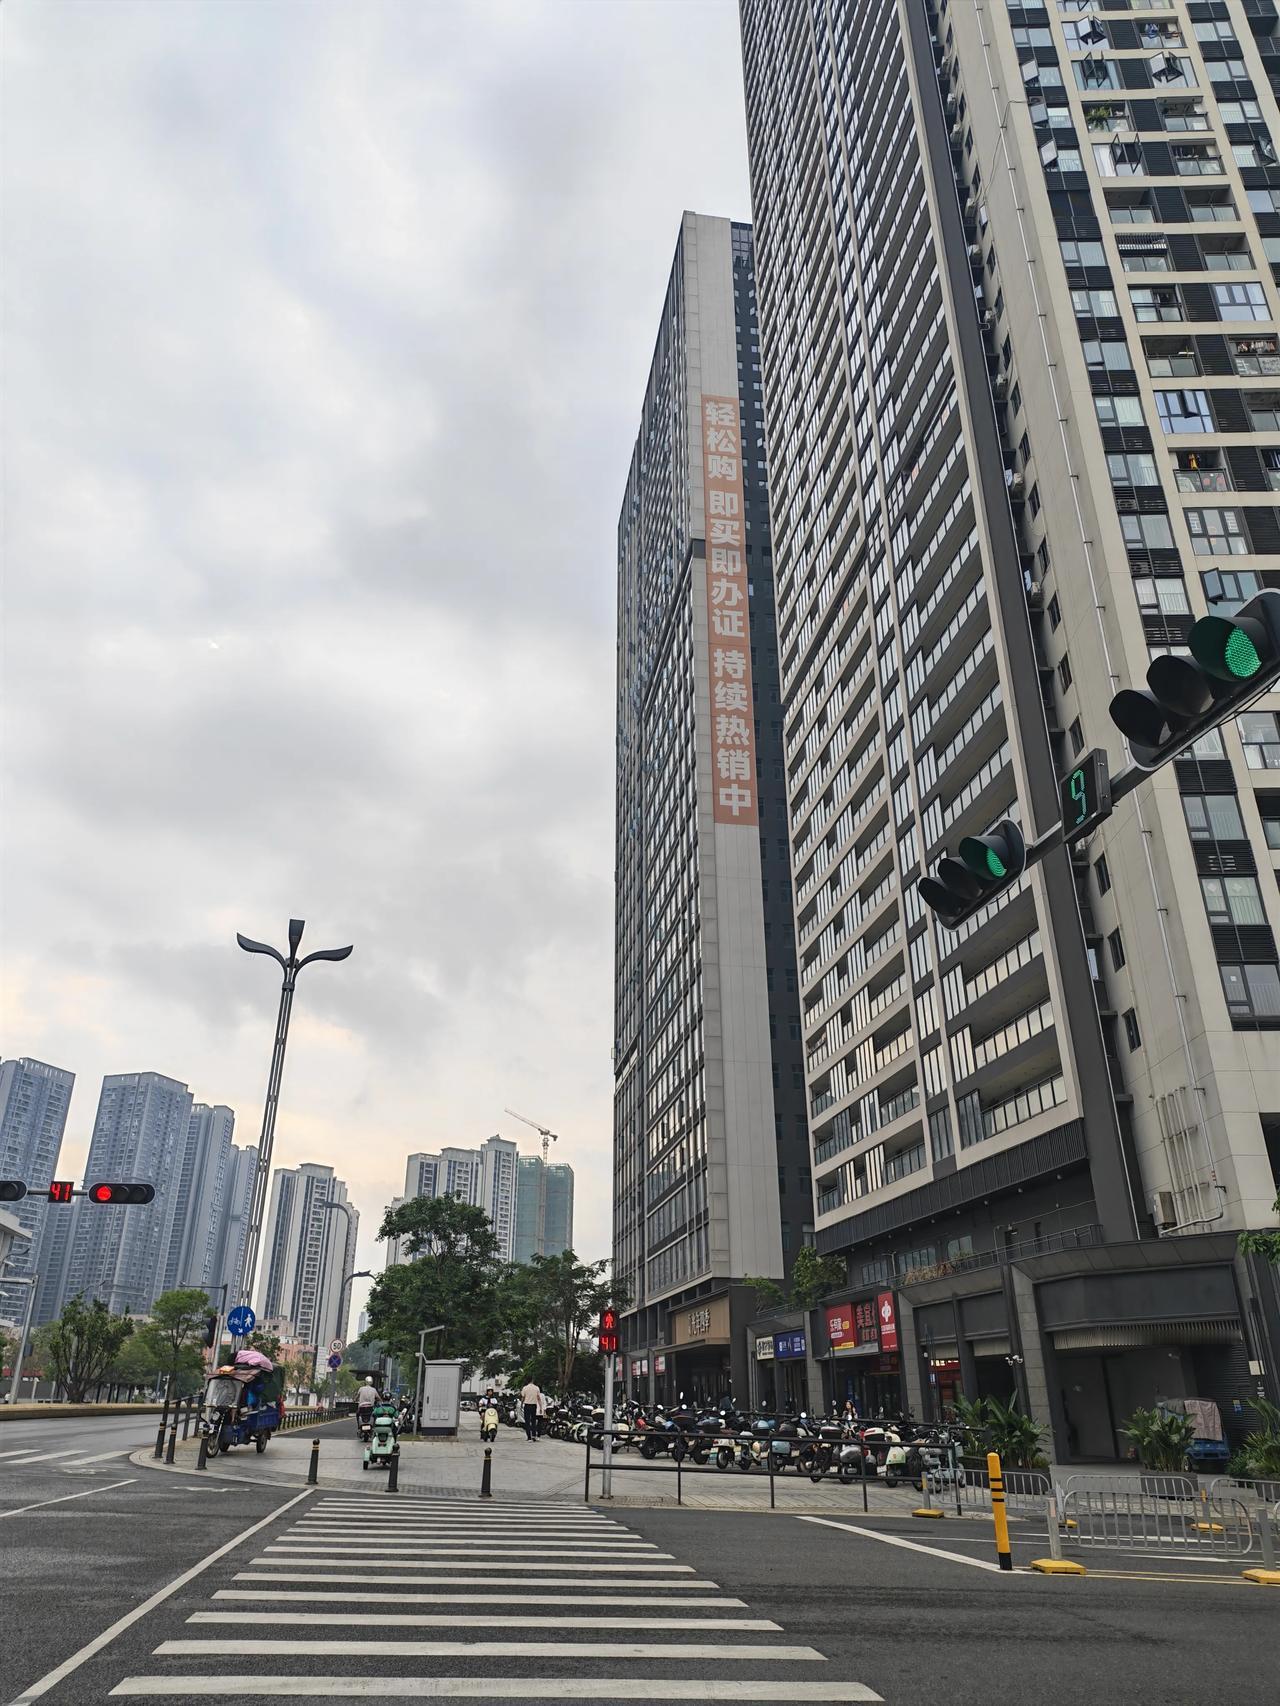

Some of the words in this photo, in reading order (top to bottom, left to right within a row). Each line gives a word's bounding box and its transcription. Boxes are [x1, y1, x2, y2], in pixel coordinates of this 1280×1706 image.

[705, 400, 737, 481] 轻松购
[709, 490, 745, 638] 即买即办证
[713, 648, 752, 817] 持续热销中
[1070, 769, 1086, 825] 9
[51, 1183, 71, 1201] 41
[601, 1336, 616, 1350] 41
